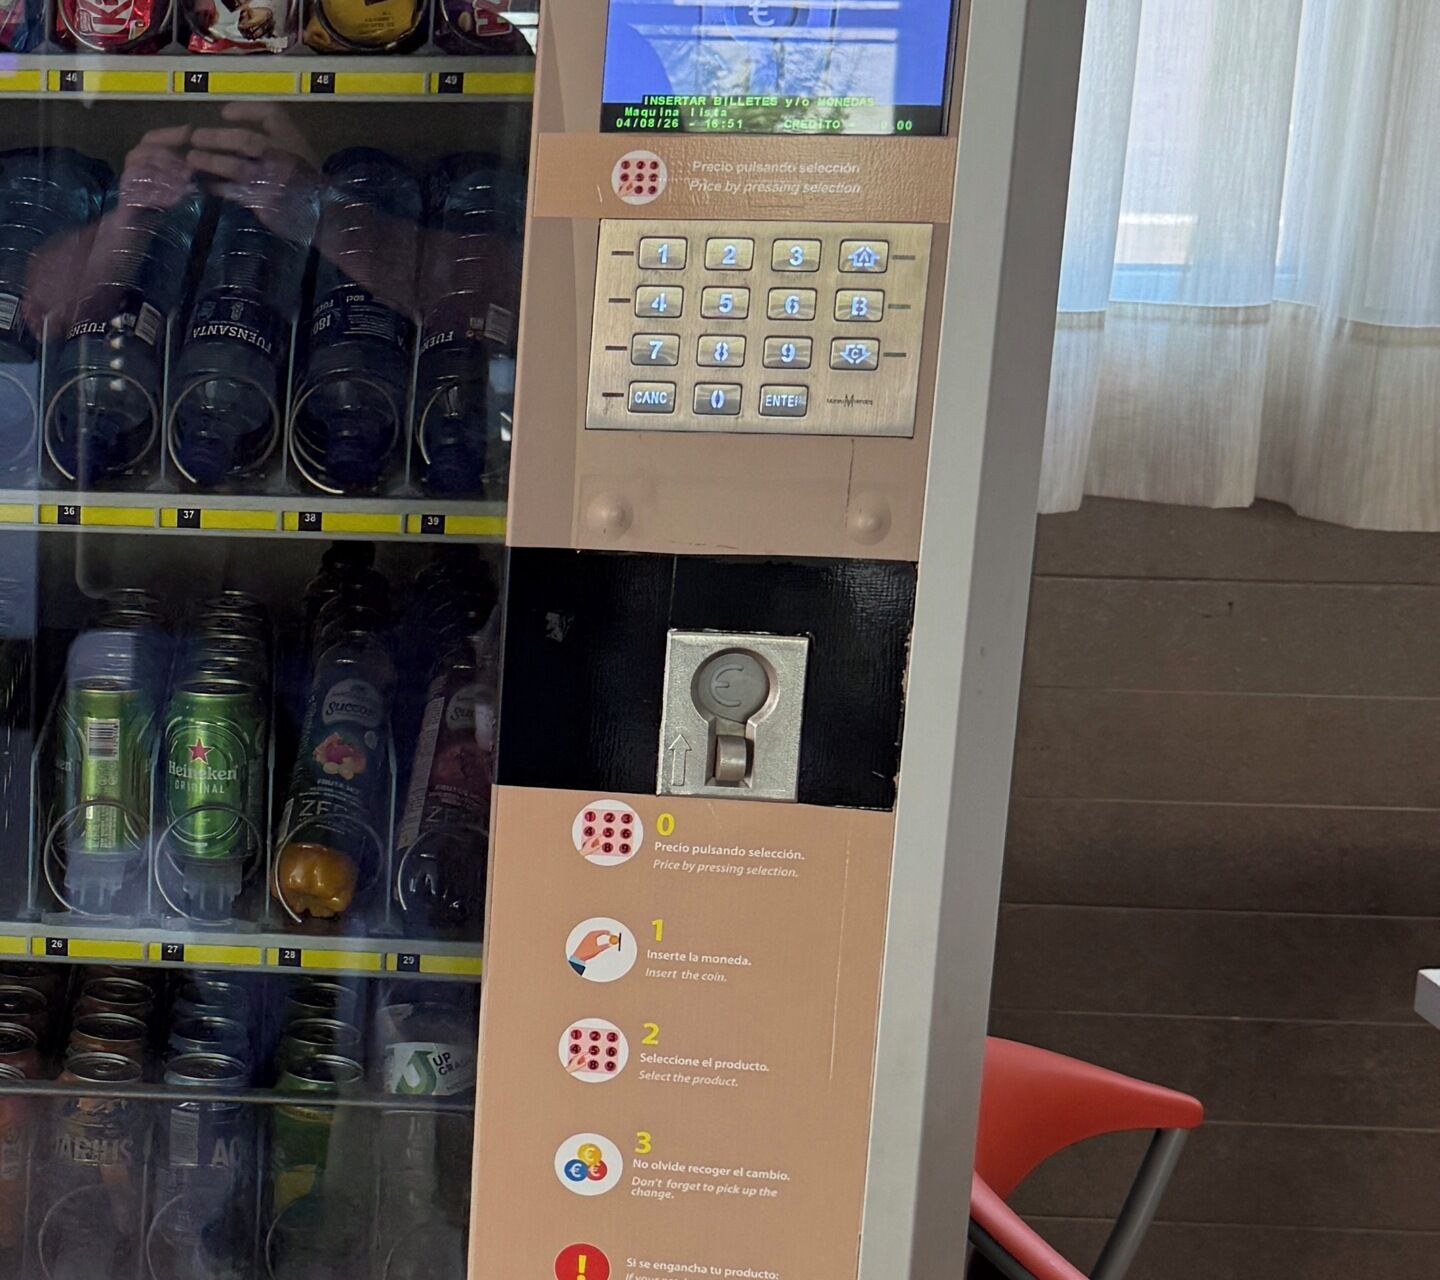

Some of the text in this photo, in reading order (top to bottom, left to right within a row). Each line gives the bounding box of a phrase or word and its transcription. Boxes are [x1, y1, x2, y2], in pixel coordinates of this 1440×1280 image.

[191, 74, 202, 84] 47
[317, 76, 329, 85] 48
[445, 76, 457, 85] 49
[644, 96, 875, 107] INSERTAR BILLETES y/o MONEDAS
[625, 107, 680, 117] Maquina
[616, 118, 679, 128] 04/08/26
[784, 120, 840, 129] CREDITO
[658, 245, 803, 265] 1 2 3
[651, 293, 867, 315] 4 5 6 B
[650, 341, 795, 362] 7 8 9
[183, 511, 195, 519] 37
[169, 760, 238, 781] Heineken
[656, 813, 675, 836] 0
[655, 841, 805, 860] Precio pulsando selección.
[653, 859, 799, 878] Price by pressing selection.
[652, 919, 664, 941] 1
[51, 940, 62, 948] 26
[167, 944, 179, 953] 27
[647, 949, 751, 966] Inserte moneda.
[646, 968, 727, 982] Insert the coin.
[642, 1023, 659, 1045] 2
[433, 1052, 450, 1066] UP
[640, 1053, 769, 1072] Seleccione producto.
[639, 1070, 738, 1088] Select the product.
[635, 1131, 652, 1154] 3
[633, 1159, 790, 1181] No olvide recoger cambio.
[631, 1176, 778, 1197] Don't forget pick up the
[631, 1188, 674, 1200] change.
[653, 1261, 779, 1280] engancha producto:
